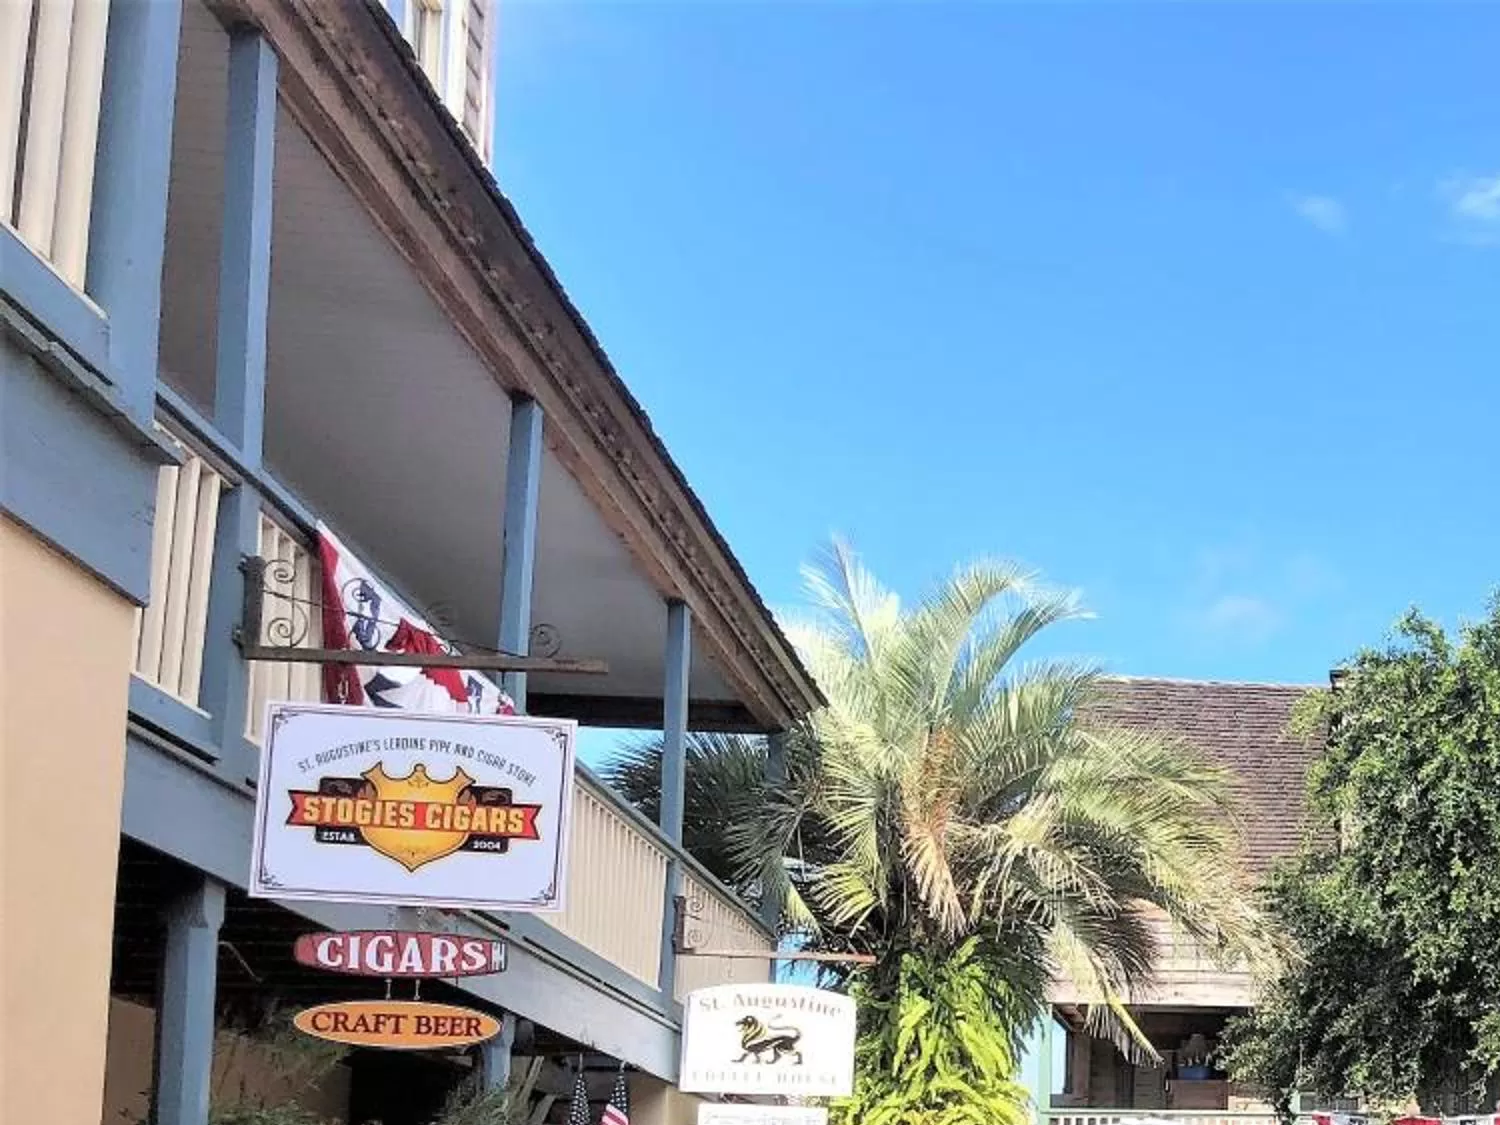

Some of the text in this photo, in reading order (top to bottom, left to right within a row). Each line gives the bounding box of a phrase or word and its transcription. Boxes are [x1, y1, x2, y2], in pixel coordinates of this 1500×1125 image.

[303, 795, 525, 834] STOGIES CIGARS
[316, 934, 487, 974] CIGARS
[733, 992, 842, 1018] Augustine
[311, 1011, 483, 1037] CRAFT BEER
